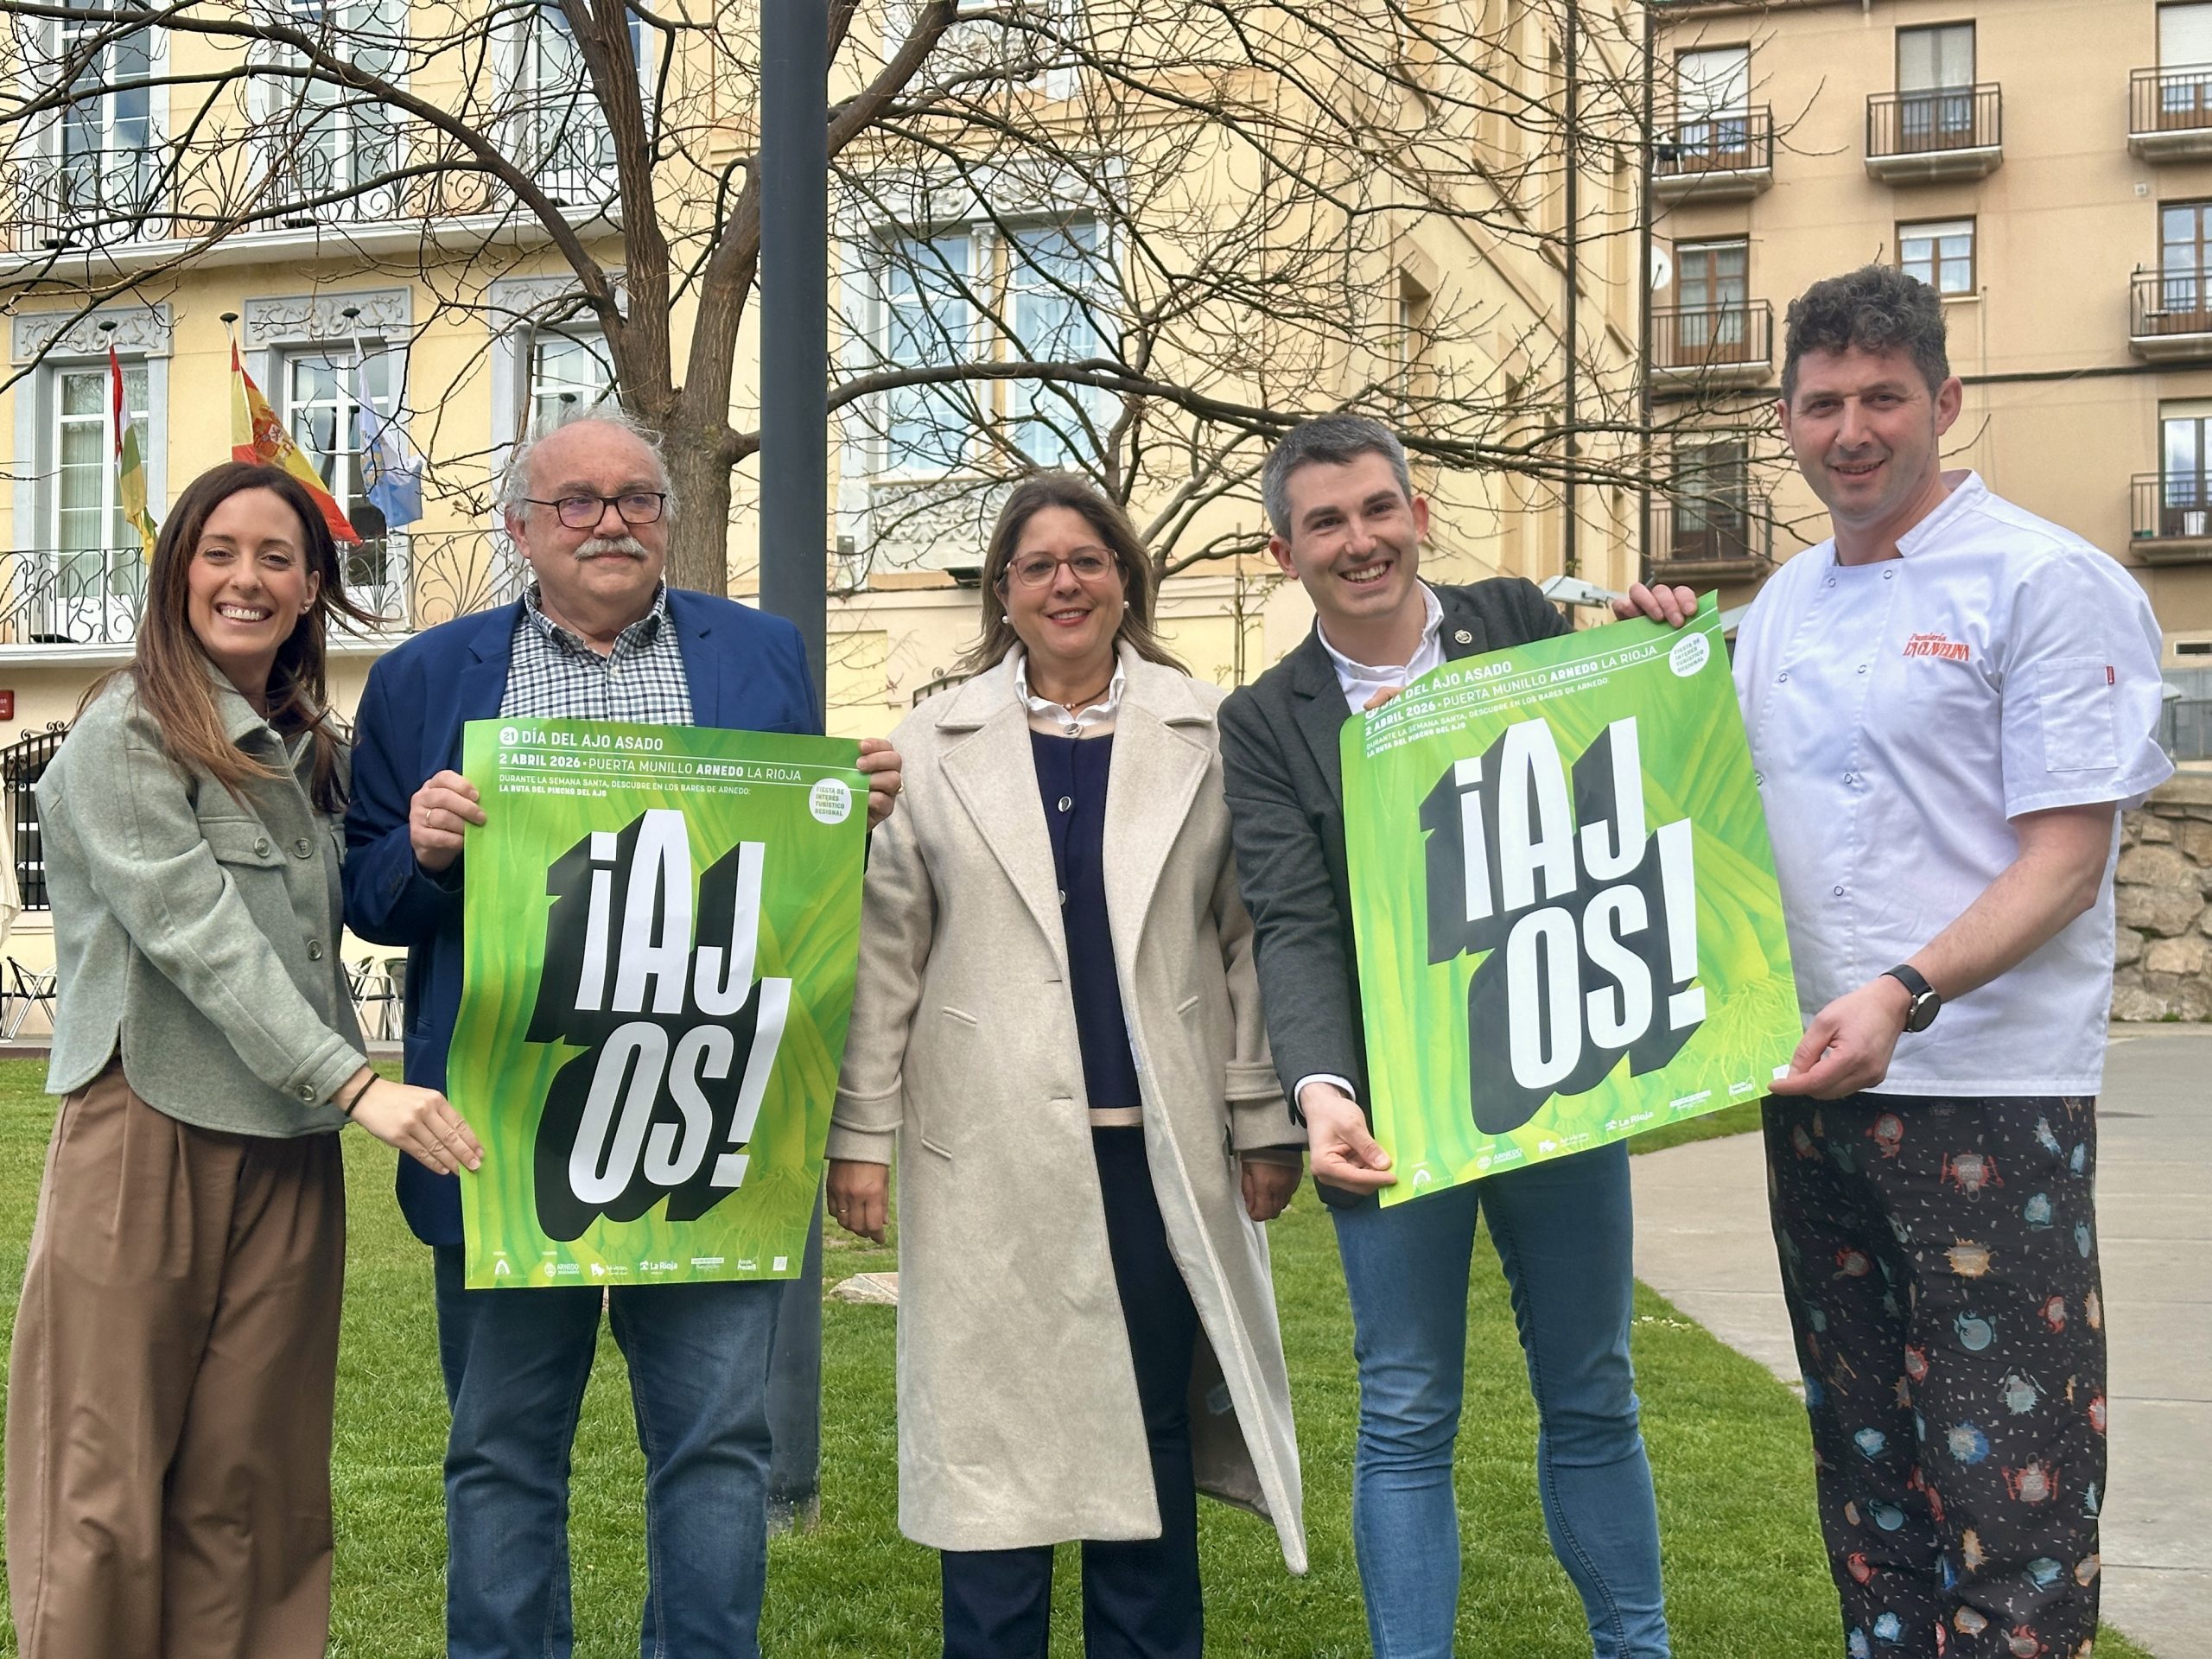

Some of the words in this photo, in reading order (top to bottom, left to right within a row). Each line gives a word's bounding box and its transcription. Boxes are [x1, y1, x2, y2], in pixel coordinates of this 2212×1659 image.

[1365, 726, 1373, 735] 2
[1374, 715, 1404, 732] ABRIL
[1407, 702, 1436, 717] 2026
[1443, 688, 1491, 706] PUERTA
[1493, 675, 1547, 696] MUNILLO
[1550, 661, 1599, 683] ARNEDO
[1601, 656, 1618, 669] LA
[1620, 645, 1658, 664] RIOJA
[1405, 683, 1428, 698] DEL
[1433, 674, 1460, 690] AJO
[1465, 661, 1512, 683] ASADO
[1366, 733, 1396, 750] DURANTE
[1408, 720, 1439, 734] SEMANA
[1469, 703, 1508, 718] DESCUBRE
[1510, 700, 1521, 709] EN
[1522, 696, 1537, 706] LOS
[1538, 690, 1563, 702] BARES
[1565, 686, 1575, 695] DE
[522, 728, 546, 744] DÍA
[551, 733, 577, 746] DEL
[582, 734, 610, 748] AJO
[614, 736, 664, 751] ASADO
[1367, 750, 1375, 759] LA
[1376, 742, 1393, 754] RUTA
[1394, 739, 1407, 747] DEL
[1436, 726, 1450, 734] DEL
[1451, 722, 1466, 731] AJO
[499, 753, 507, 765] 2
[512, 754, 546, 766] ABRIL
[550, 756, 581, 768] 2026
[588, 758, 635, 772] PUERTA
[639, 760, 692, 774] MUNILLO
[696, 764, 743, 777] ARNEDO
[747, 766, 762, 779] LA
[766, 769, 802, 781] RIOJA
[499, 774, 536, 784] DURANTE
[549, 777, 581, 785] SEMANA
[583, 779, 609, 788] SANTA,
[612, 780, 651, 790] DESCUBRE
[664, 783, 679, 791] LOS
[680, 785, 705, 793] BARES
[548, 787, 575, 796] PINCHO
[817, 786, 835, 795] FIESTA
[1454, 715, 1646, 922] ¡AJ
[574, 809, 766, 1017] ¡AJ
[1506, 817, 1707, 1090] OS!
[569, 977, 792, 1204] OS!
[1618, 1118, 1629, 1128] La
[1630, 1110, 1654, 1123] Rioja
[651, 1262, 658, 1270] La
[660, 1262, 678, 1272] Rioja
